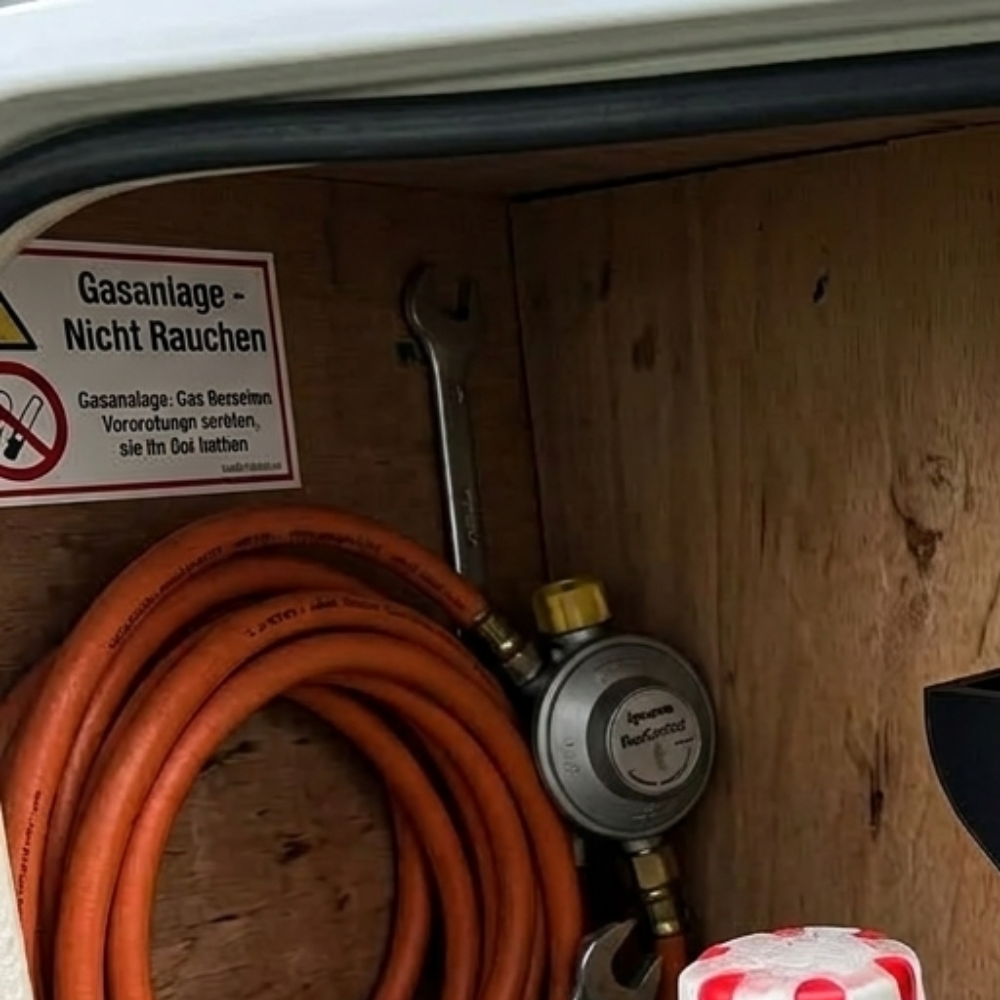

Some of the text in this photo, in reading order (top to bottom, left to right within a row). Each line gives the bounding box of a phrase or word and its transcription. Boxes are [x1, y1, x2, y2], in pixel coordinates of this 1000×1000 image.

[78, 271, 224, 314] Gasanlage
[63, 317, 267, 352] Nicht Rauchen
[176, 391, 204, 407] Gas
